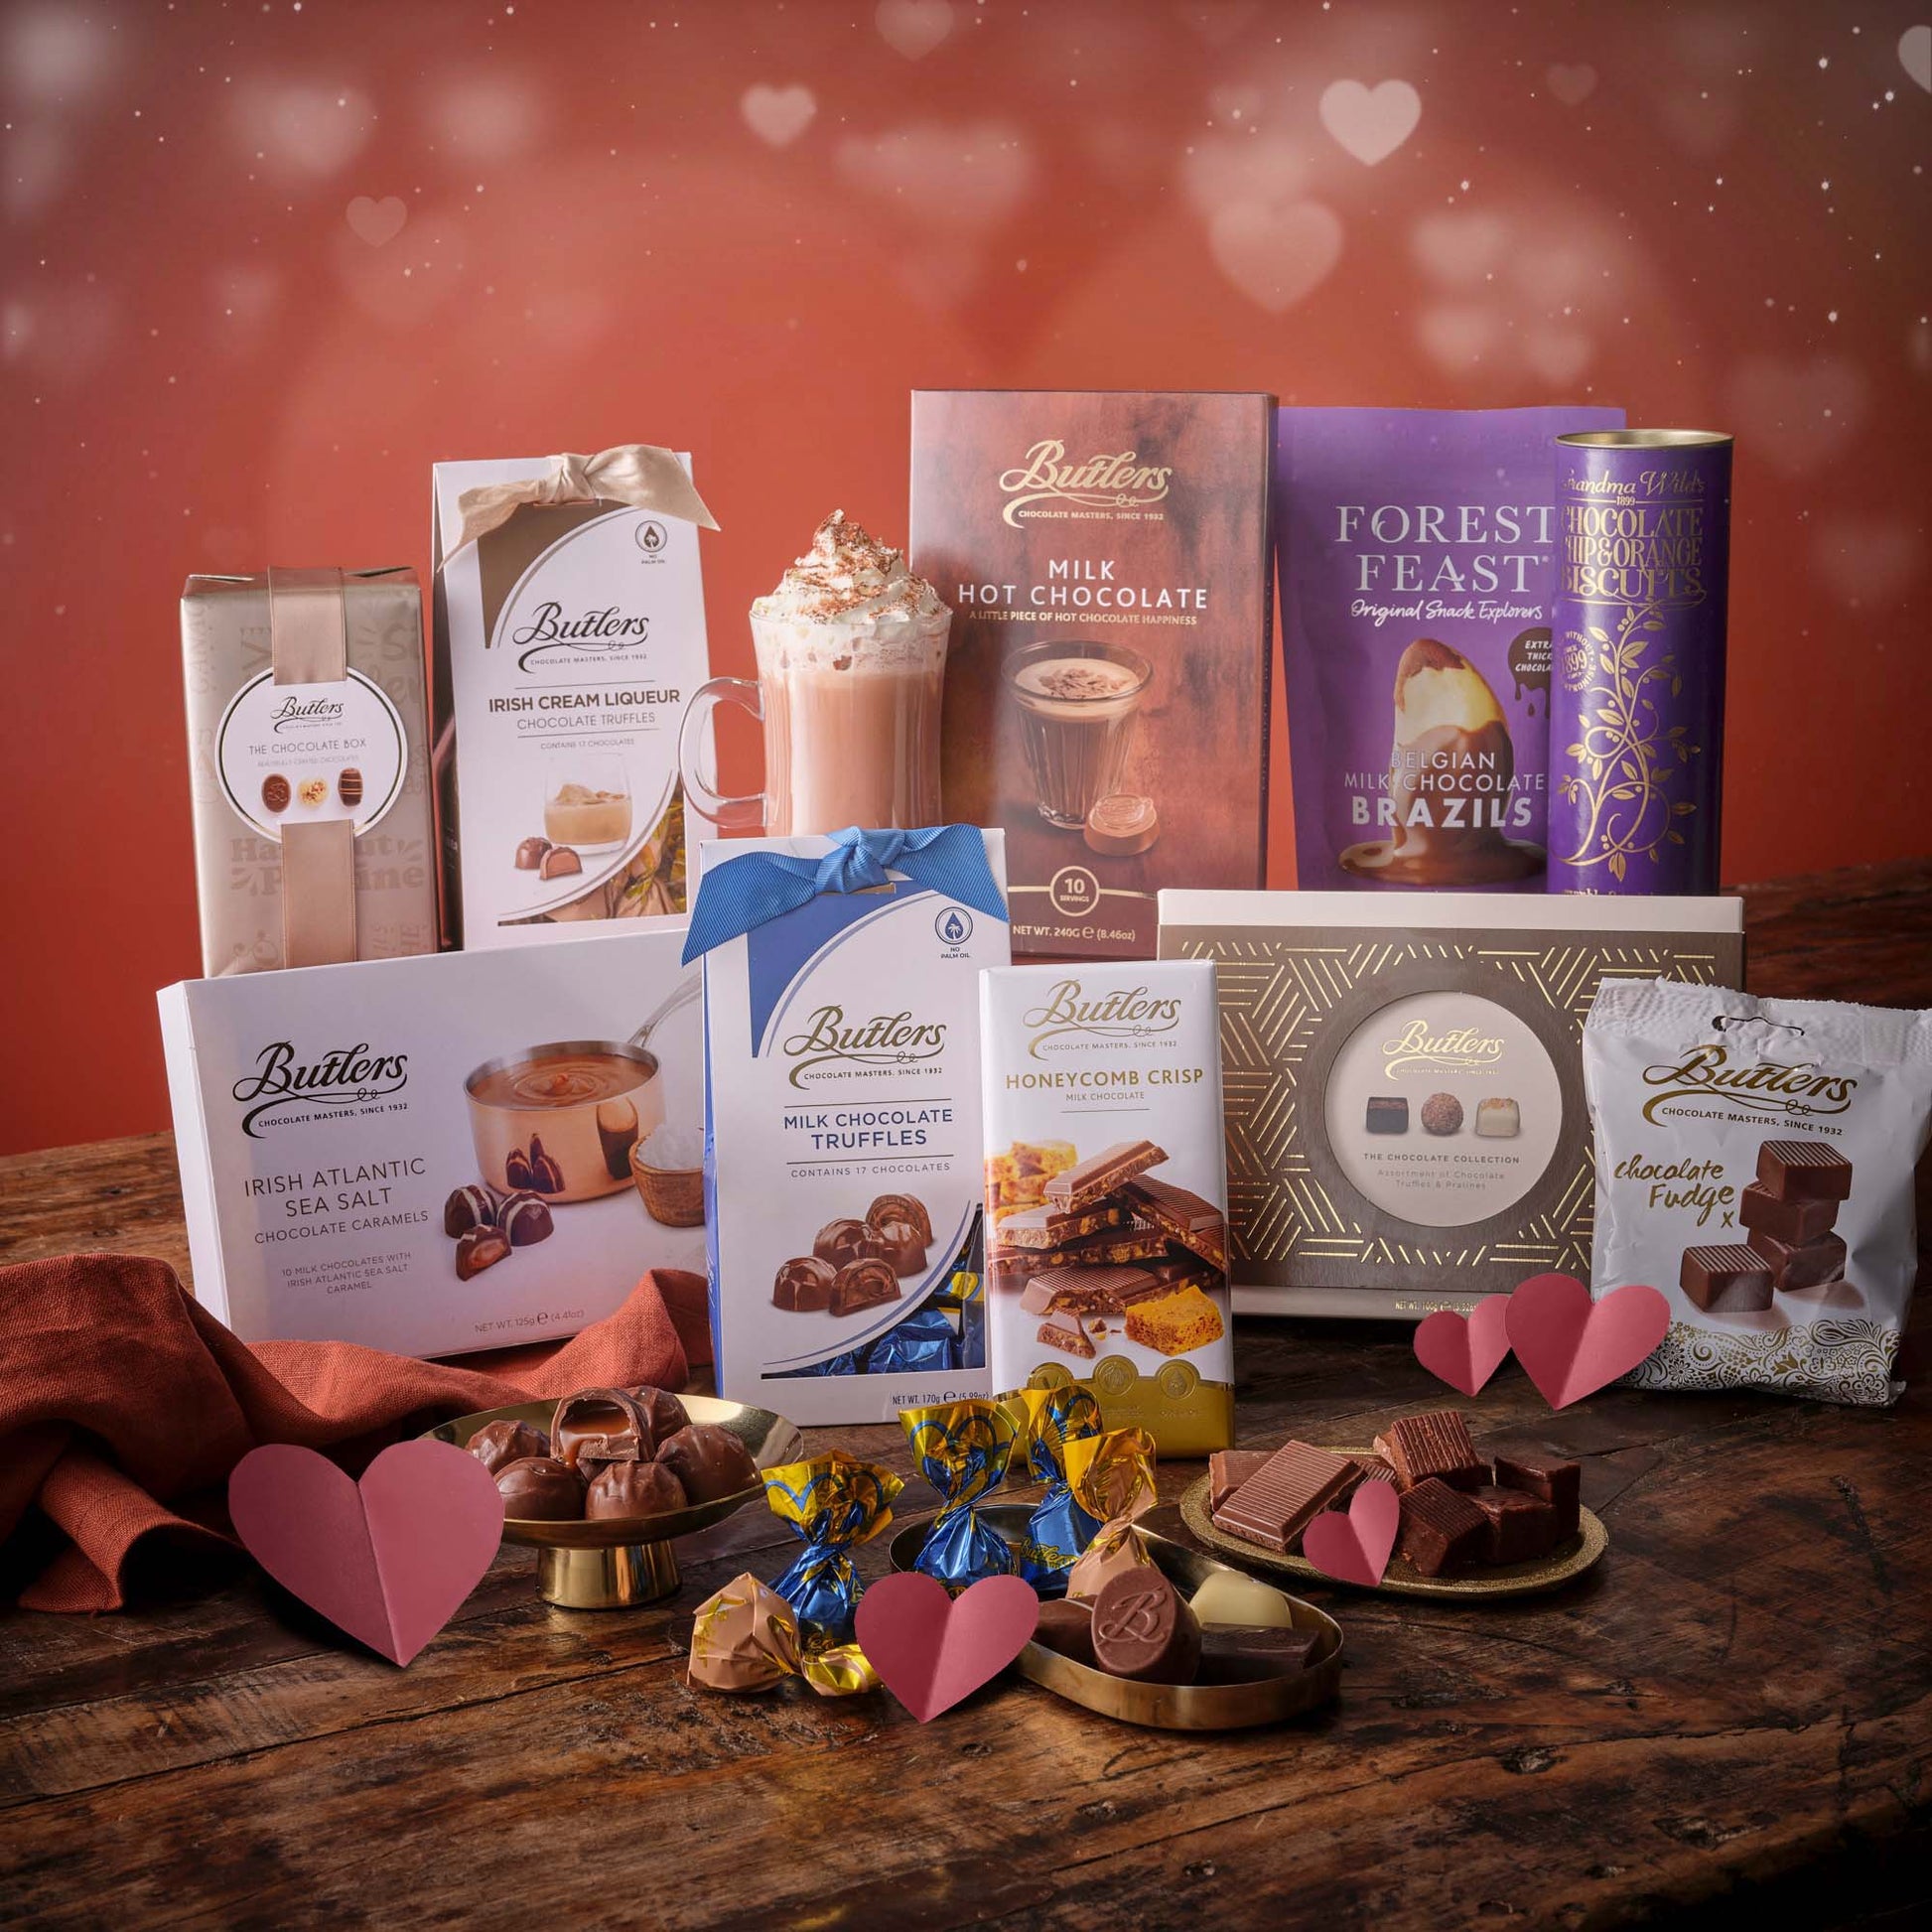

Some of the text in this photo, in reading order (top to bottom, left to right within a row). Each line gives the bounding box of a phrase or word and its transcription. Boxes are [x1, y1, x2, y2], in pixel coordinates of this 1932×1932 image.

[1000, 439, 1173, 507] Butlers
[1615, 496, 1636, 506] 1899
[1019, 509, 1068, 519] CHOCOLATE
[1334, 505, 1556, 544] FOREST
[1048, 559, 1115, 581] MILK
[1355, 554, 1538, 593] FEAST
[958, 584, 1207, 610] HOT CHOCOLATE
[978, 611, 1009, 621] LITTLE
[1010, 612, 1037, 621] PIECE
[1038, 612, 1052, 621] OF
[1054, 612, 1077, 622] HOT
[1078, 613, 1140, 623] CHOCOLATE
[1142, 614, 1197, 625] HAPPINESS
[1350, 599, 1543, 627] Original Snack Explorers
[512, 601, 649, 651] Butlers
[1515, 663, 1552, 672] CHOCOLA
[270, 696, 344, 722] Butlers
[489, 689, 680, 712] IRISH CREAM LIQUEUR
[517, 712, 655, 730] CHOCOLATE TRUFFLES
[249, 738, 366, 755] THE CHOCOLATE BOX
[540, 741, 576, 750] CONTAINS
[588, 738, 634, 748] CHOCOLATES
[1391, 751, 1495, 769] BELGIAN
[1344, 772, 1545, 792] MILK CHOCOLATE
[1352, 795, 1533, 828] BRAZILS
[1064, 878, 1085, 894] 10
[1013, 925, 1032, 935] NET
[1034, 926, 1052, 936] WT.
[1053, 926, 1080, 938] 240G
[1096, 928, 1136, 942] (8.46oz)
[1023, 979, 1181, 1036] Butlers
[783, 1005, 946, 1064] Butlers
[1382, 1020, 1504, 1066] Butlers
[232, 1040, 408, 1104] Butlers
[803, 1071, 852, 1080] CHOCOLATE
[1006, 1068, 1204, 1089] HONEYCOMB CRISP
[1642, 1044, 1858, 1115] Butlers
[1065, 1091, 1145, 1102] MILK CHOCOLATE
[258, 1114, 311, 1128] CHOCOLATE
[314, 1109, 357, 1121] MASTERS,
[360, 1106, 384, 1115] SINCE
[784, 1108, 953, 1130] MILK CHOCOLATE
[1661, 1107, 1843, 1137] CHOCOLATE MASTERS, SINCE 1932
[811, 1129, 927, 1150] TRUFFLES
[1387, 1154, 1449, 1163] CHOCOLATE
[1453, 1155, 1520, 1164] COLLECTION
[244, 1158, 426, 1197] IRISH ATLANTIC
[790, 1167, 851, 1178] CONTAINS
[872, 1163, 950, 1174] CHOCOLATES
[1378, 1169, 1435, 1177] Assortment
[1453, 1171, 1505, 1179] Chocolate
[286, 1187, 392, 1217] SEA SALT
[1648, 1183, 1734, 1227] Fudge
[255, 1210, 429, 1244] CHOCOLATE CARAMELS
[282, 1251, 411, 1277] 10 MILK CHOCOLATES WITH
[287, 1264, 408, 1288] IRISH ATLANTIC SEA SALT
[327, 1281, 372, 1295] CARAMEL
[475, 1322, 493, 1332] NET
[515, 1316, 535, 1326] 125g
[893, 1396, 905, 1405] NET
[922, 1394, 940, 1404] 170g
